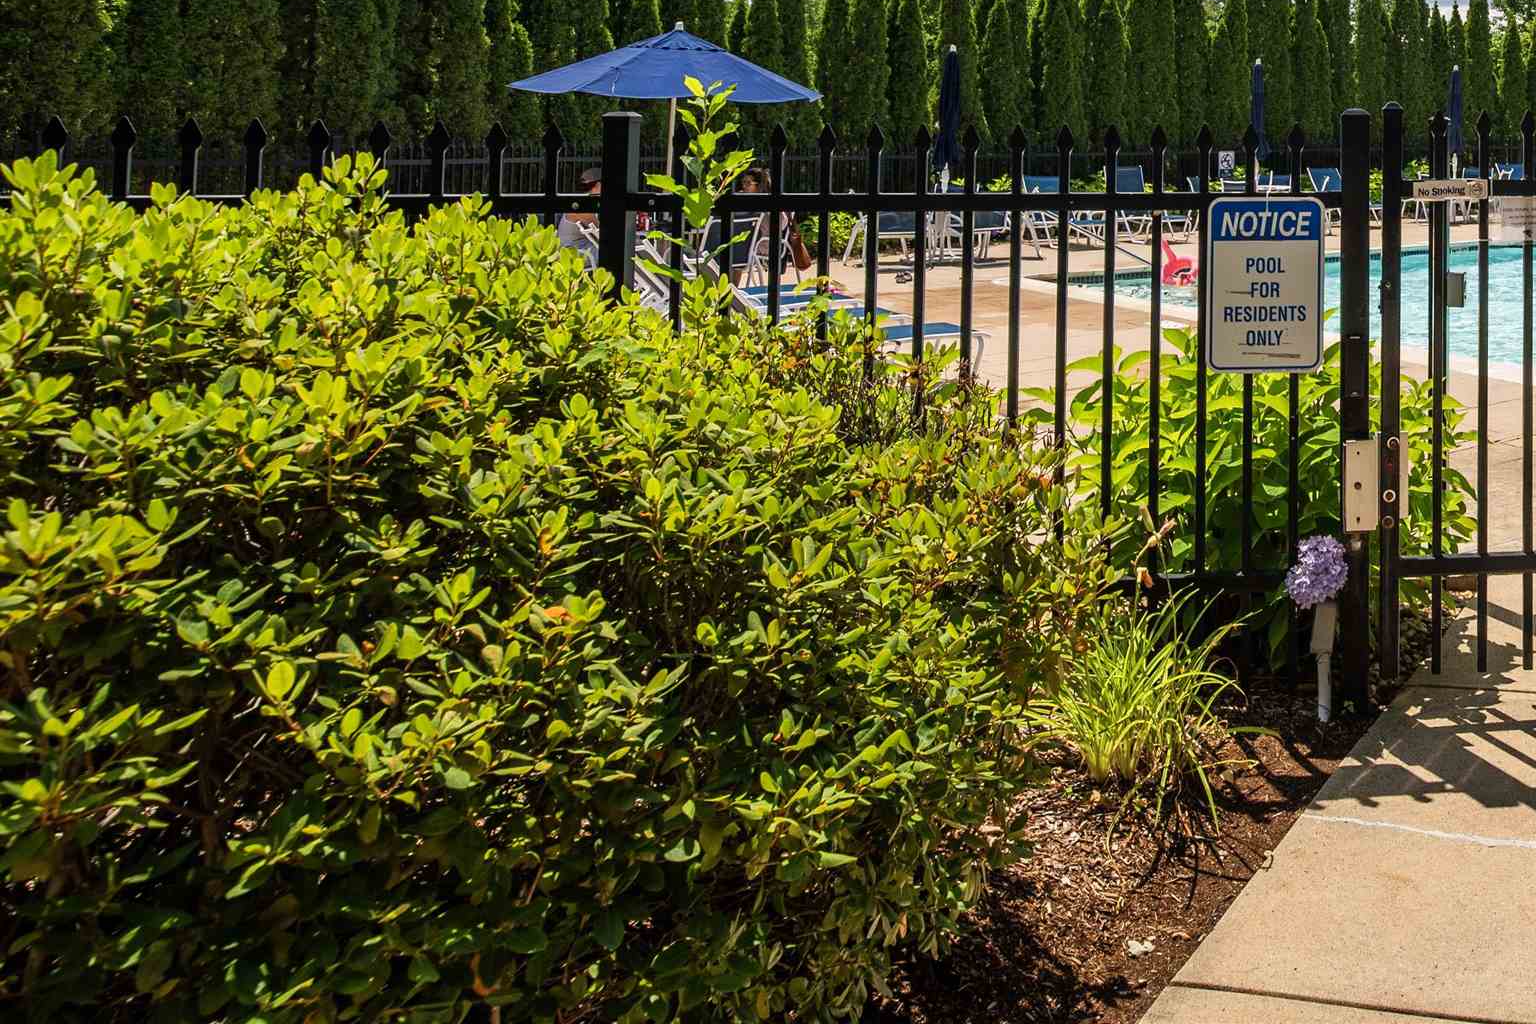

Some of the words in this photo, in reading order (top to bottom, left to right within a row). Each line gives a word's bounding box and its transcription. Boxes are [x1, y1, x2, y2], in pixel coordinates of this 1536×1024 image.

[1418, 188, 1429, 196] No
[1432, 186, 1466, 196] Smoking
[1220, 211, 1312, 237] NOTICE
[1246, 257, 1285, 274] POOL
[1250, 282, 1280, 298] FOR
[1223, 305, 1306, 322] RESIDENTS
[1246, 330, 1284, 346] ONLY
